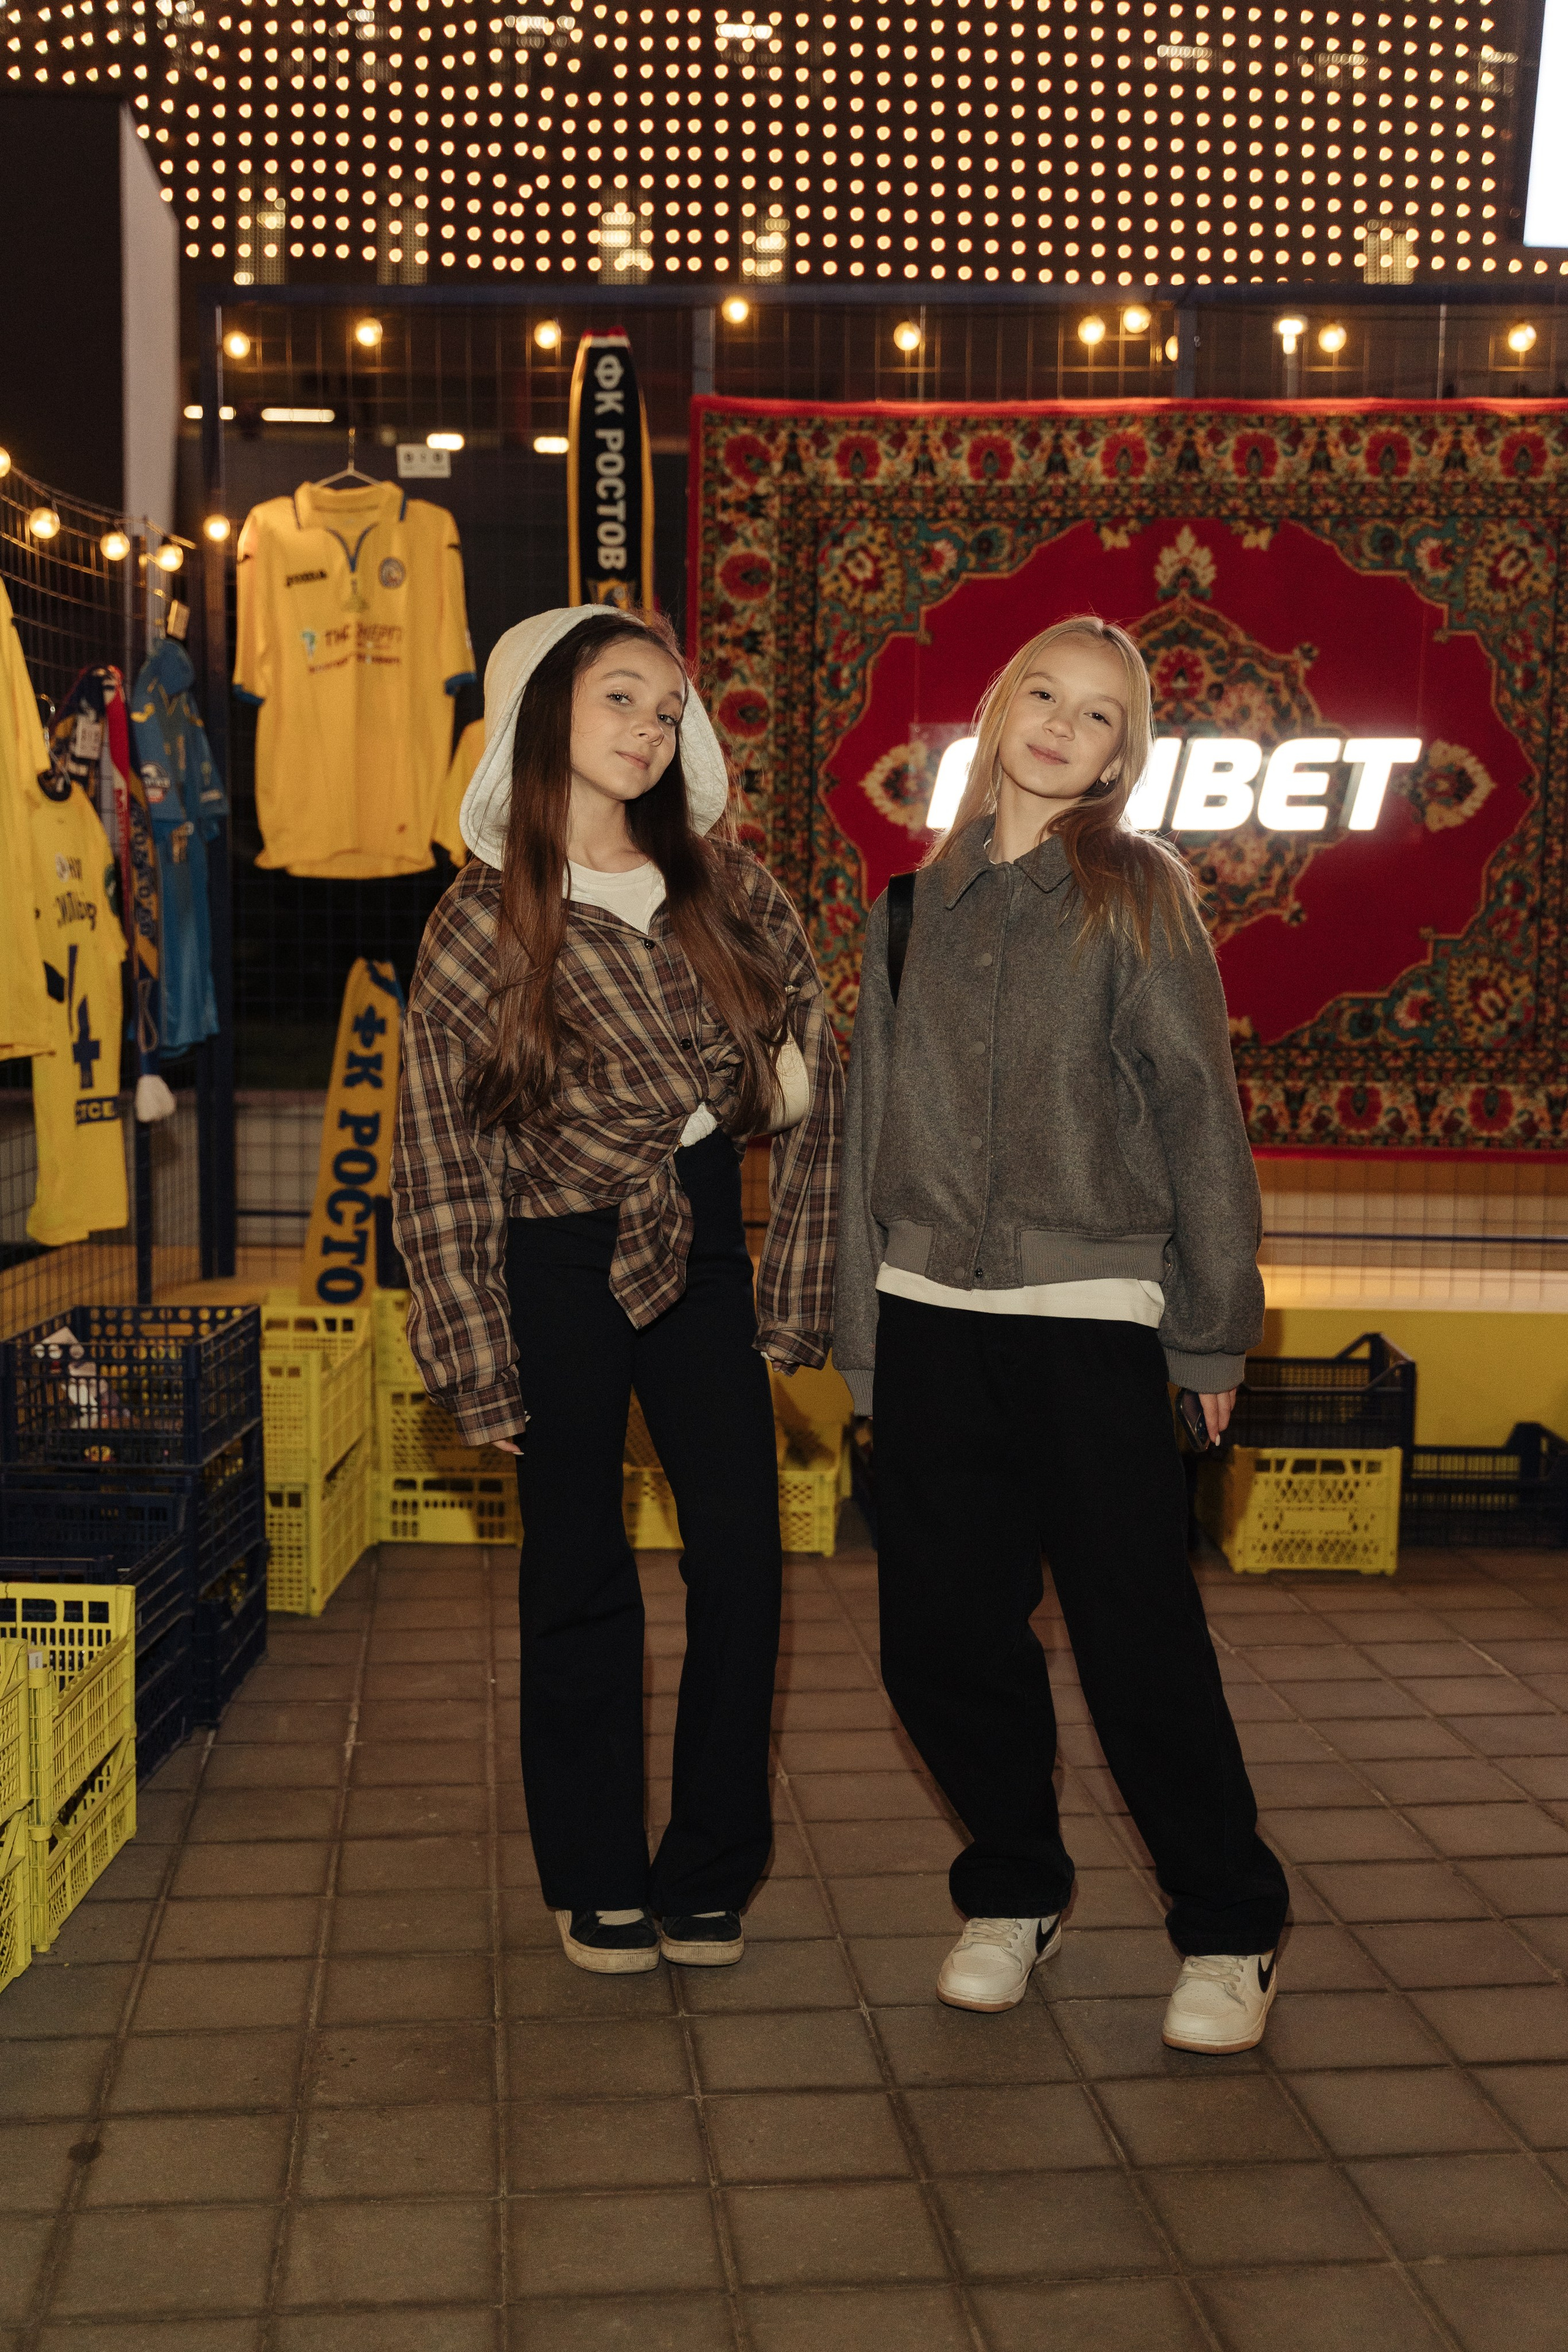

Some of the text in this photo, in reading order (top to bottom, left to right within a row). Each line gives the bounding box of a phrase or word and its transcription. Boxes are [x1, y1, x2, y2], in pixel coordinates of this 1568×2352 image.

[594, 353, 628, 571] ФК РОСТОВ
[925, 737, 1423, 832] BET
